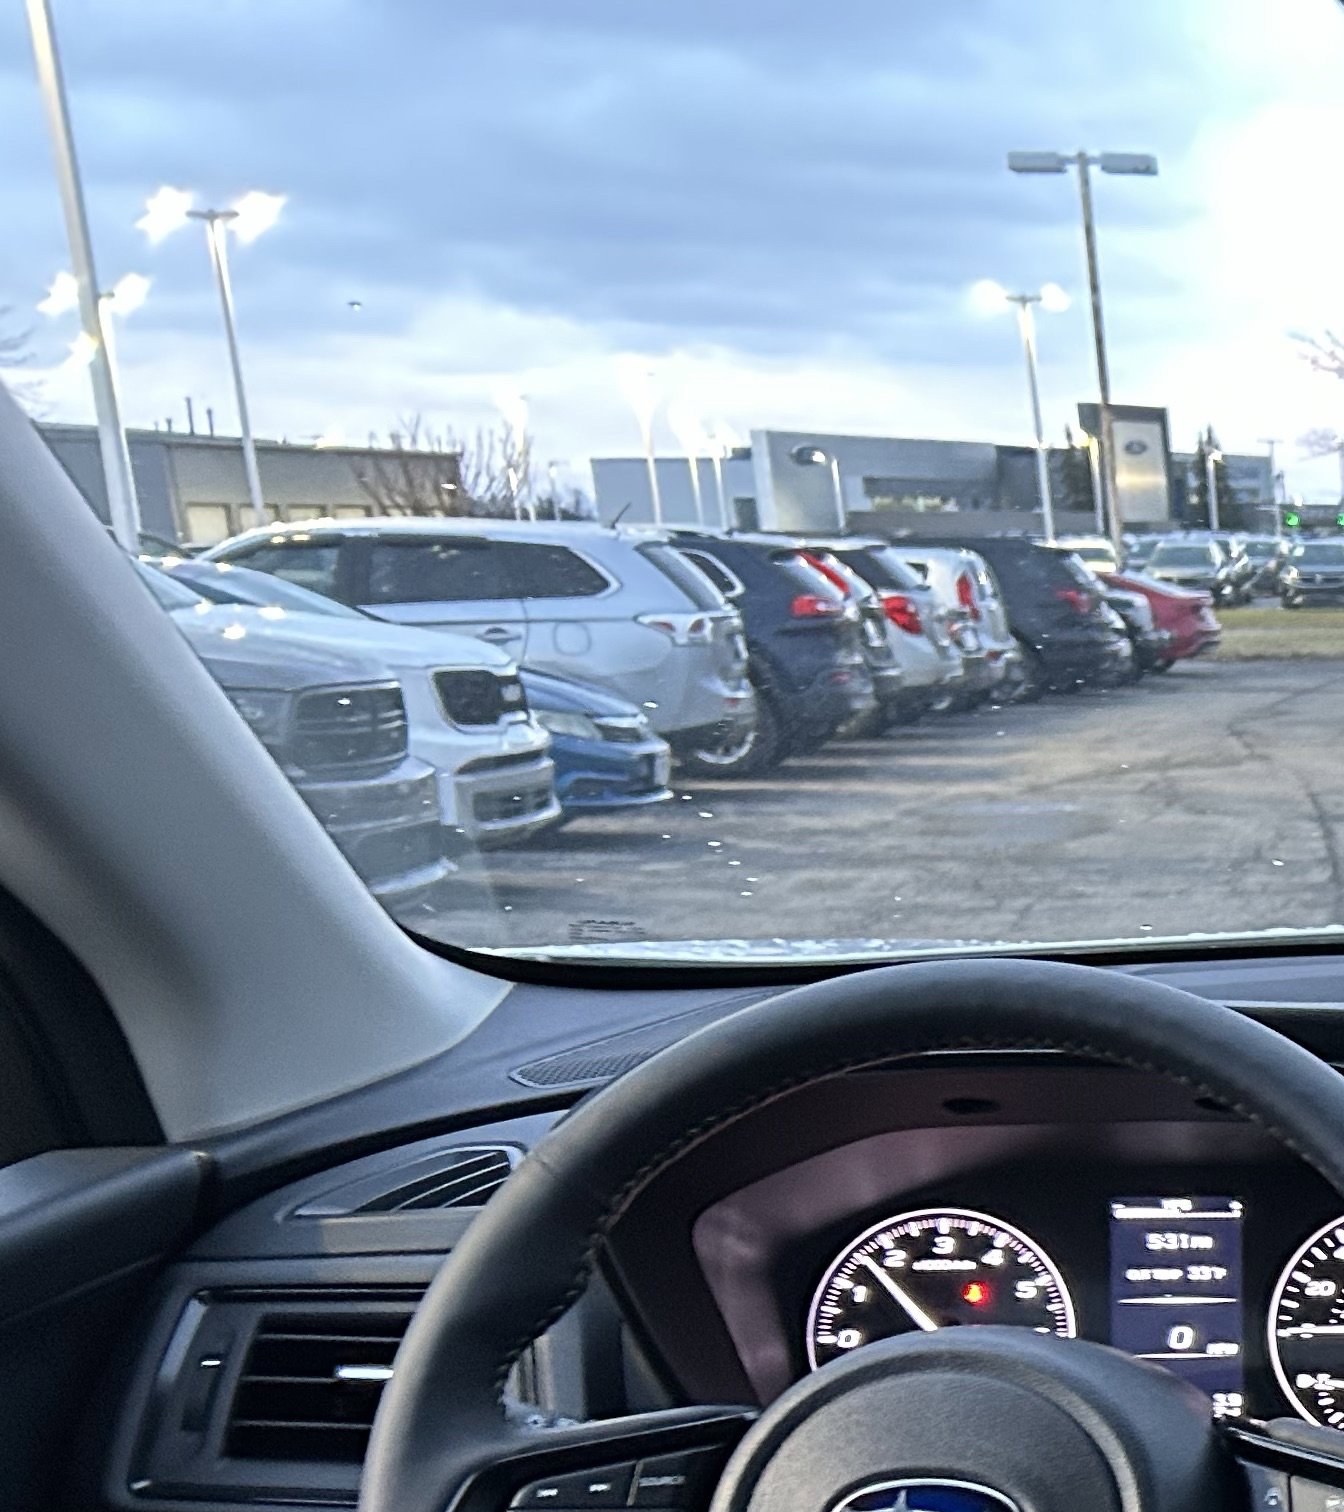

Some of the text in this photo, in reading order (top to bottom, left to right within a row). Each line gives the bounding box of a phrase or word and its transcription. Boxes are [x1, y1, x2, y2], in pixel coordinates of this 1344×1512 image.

[932, 1236, 955, 1254] 3
[884, 1249, 907, 1268] 2
[981, 1248, 1004, 1266] 4
[848, 1284, 868, 1303] 1
[1015, 1279, 1038, 1299] 5
[1304, 1280, 1336, 1297] 20
[837, 1329, 862, 1349] 0
[1167, 1325, 1194, 1350] 0
